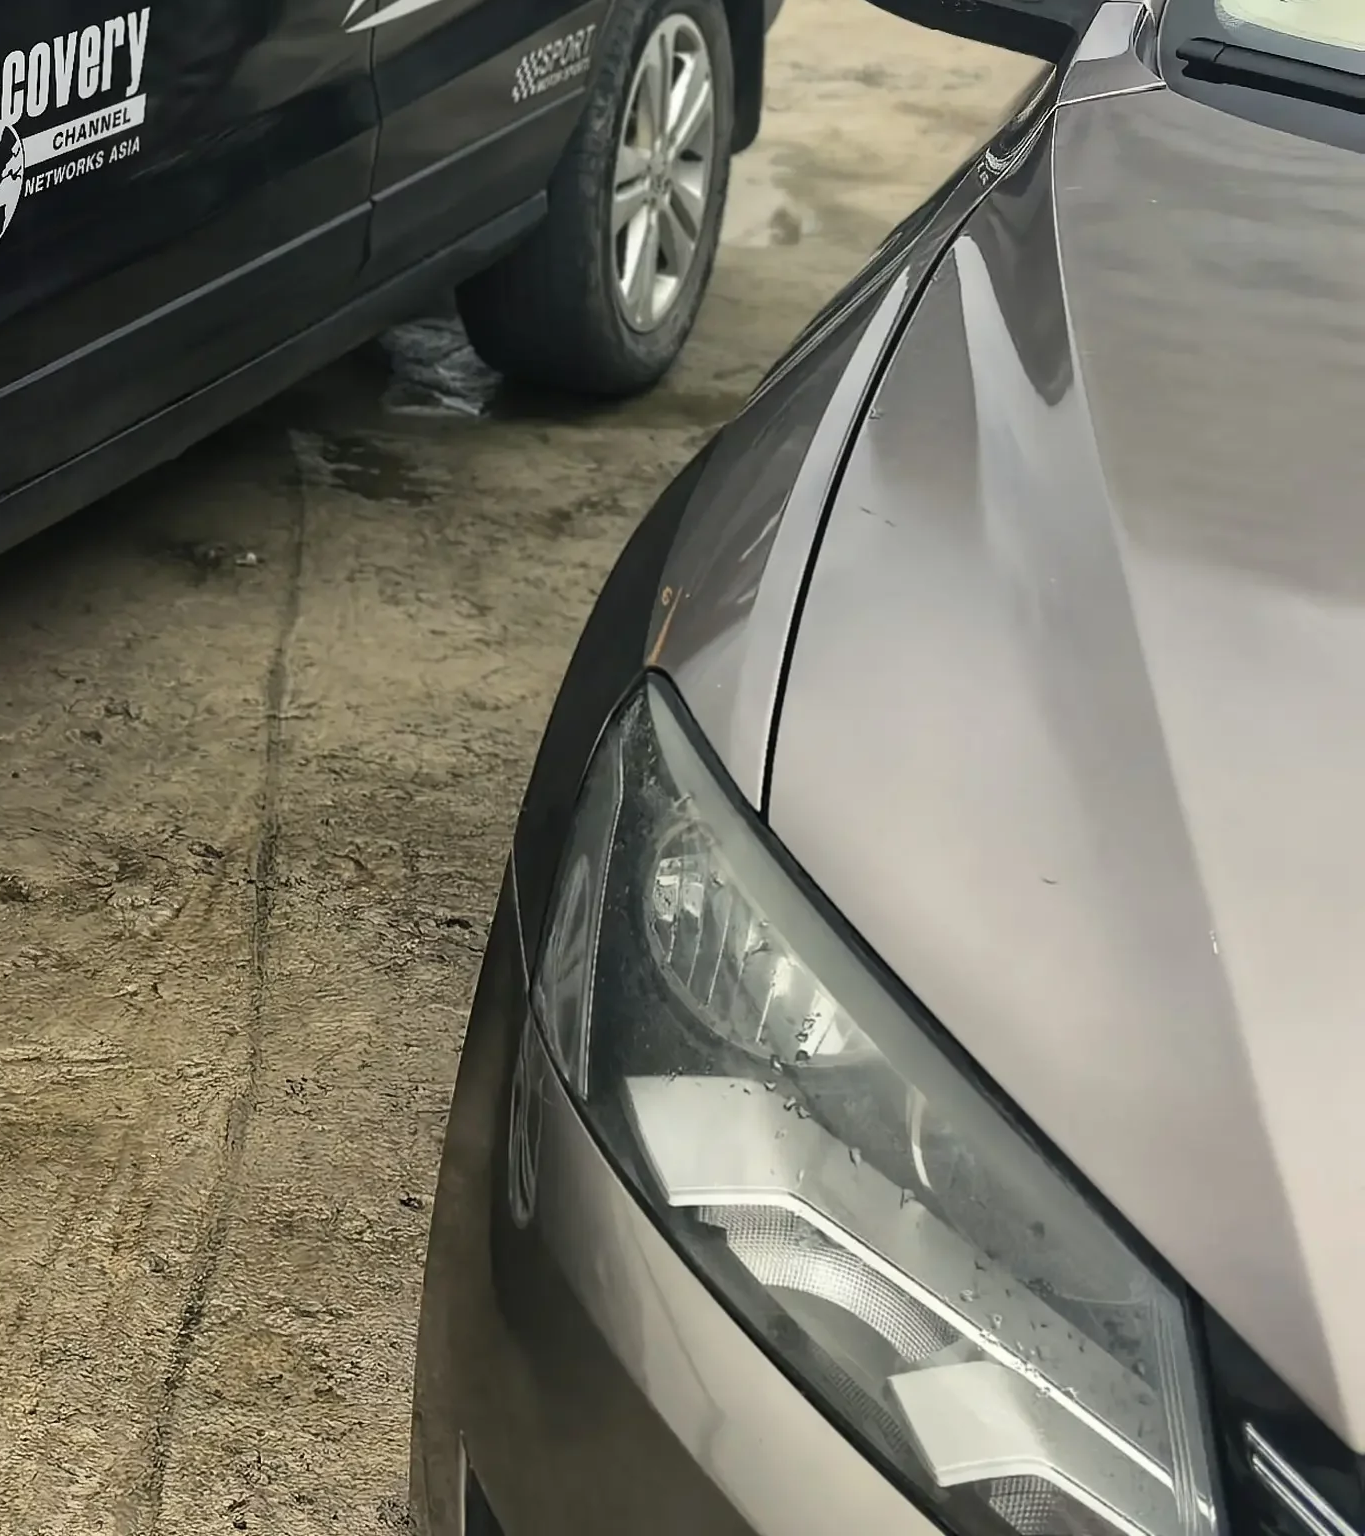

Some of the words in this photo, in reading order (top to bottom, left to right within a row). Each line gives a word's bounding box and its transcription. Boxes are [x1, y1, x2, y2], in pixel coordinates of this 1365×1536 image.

[52, 107, 132, 151] CHANNEL
[24, 151, 105, 197] NETWORKS
[108, 135, 141, 164] ASIA
